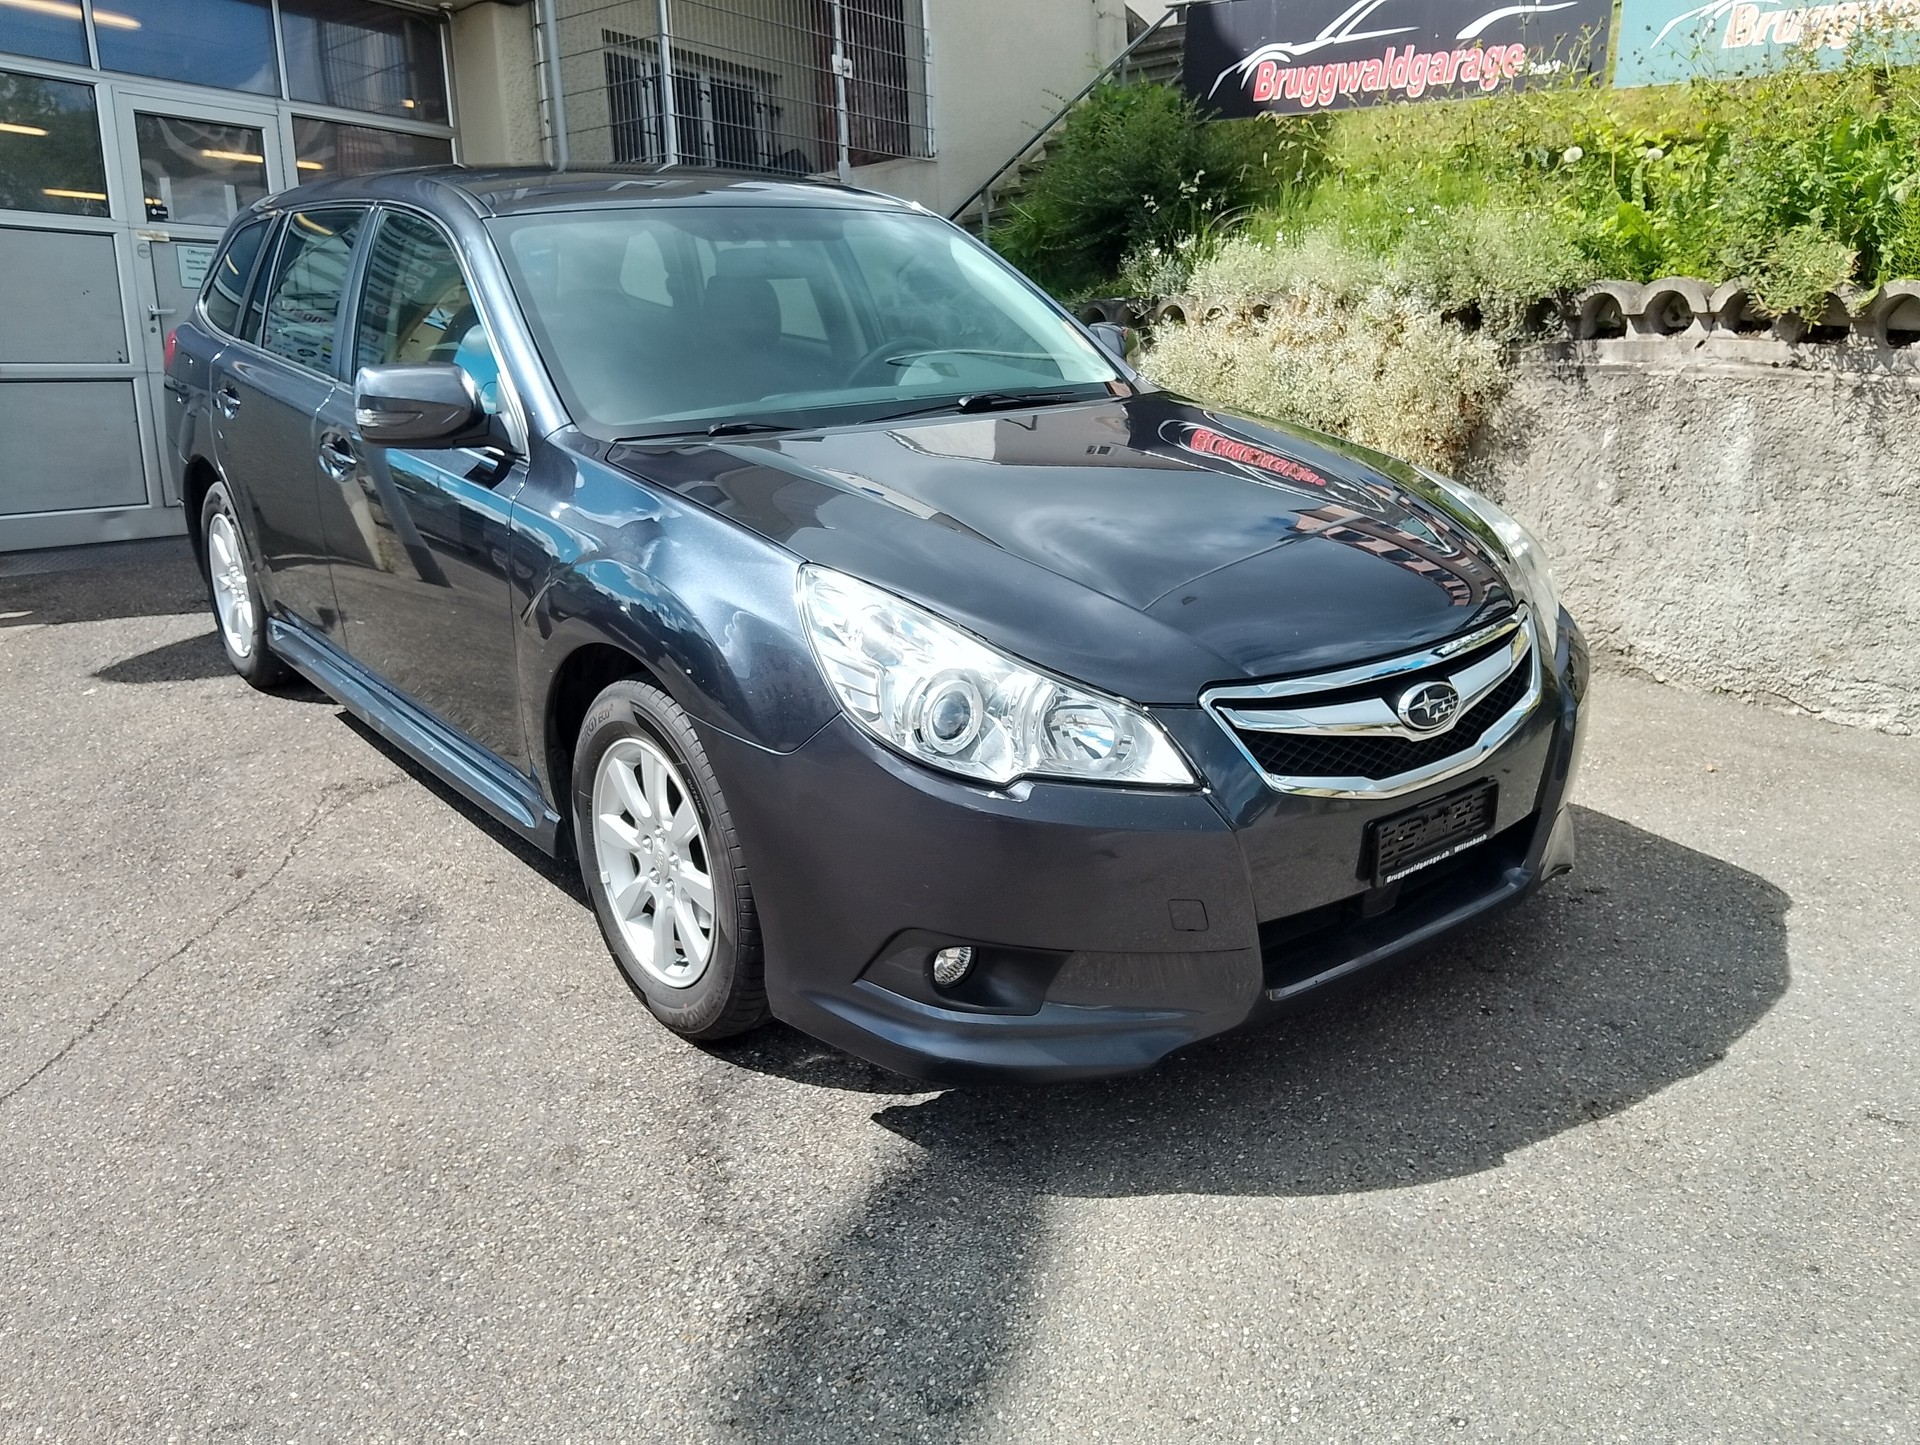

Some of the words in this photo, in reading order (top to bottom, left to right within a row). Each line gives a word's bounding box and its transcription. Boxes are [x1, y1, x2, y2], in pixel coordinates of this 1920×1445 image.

[1253, 43, 1527, 107] Bruggwaldgarage
[1386, 850, 1450, 883] Bruggwaldgarage.ch
[1454, 833, 1487, 853] Wittenbach
